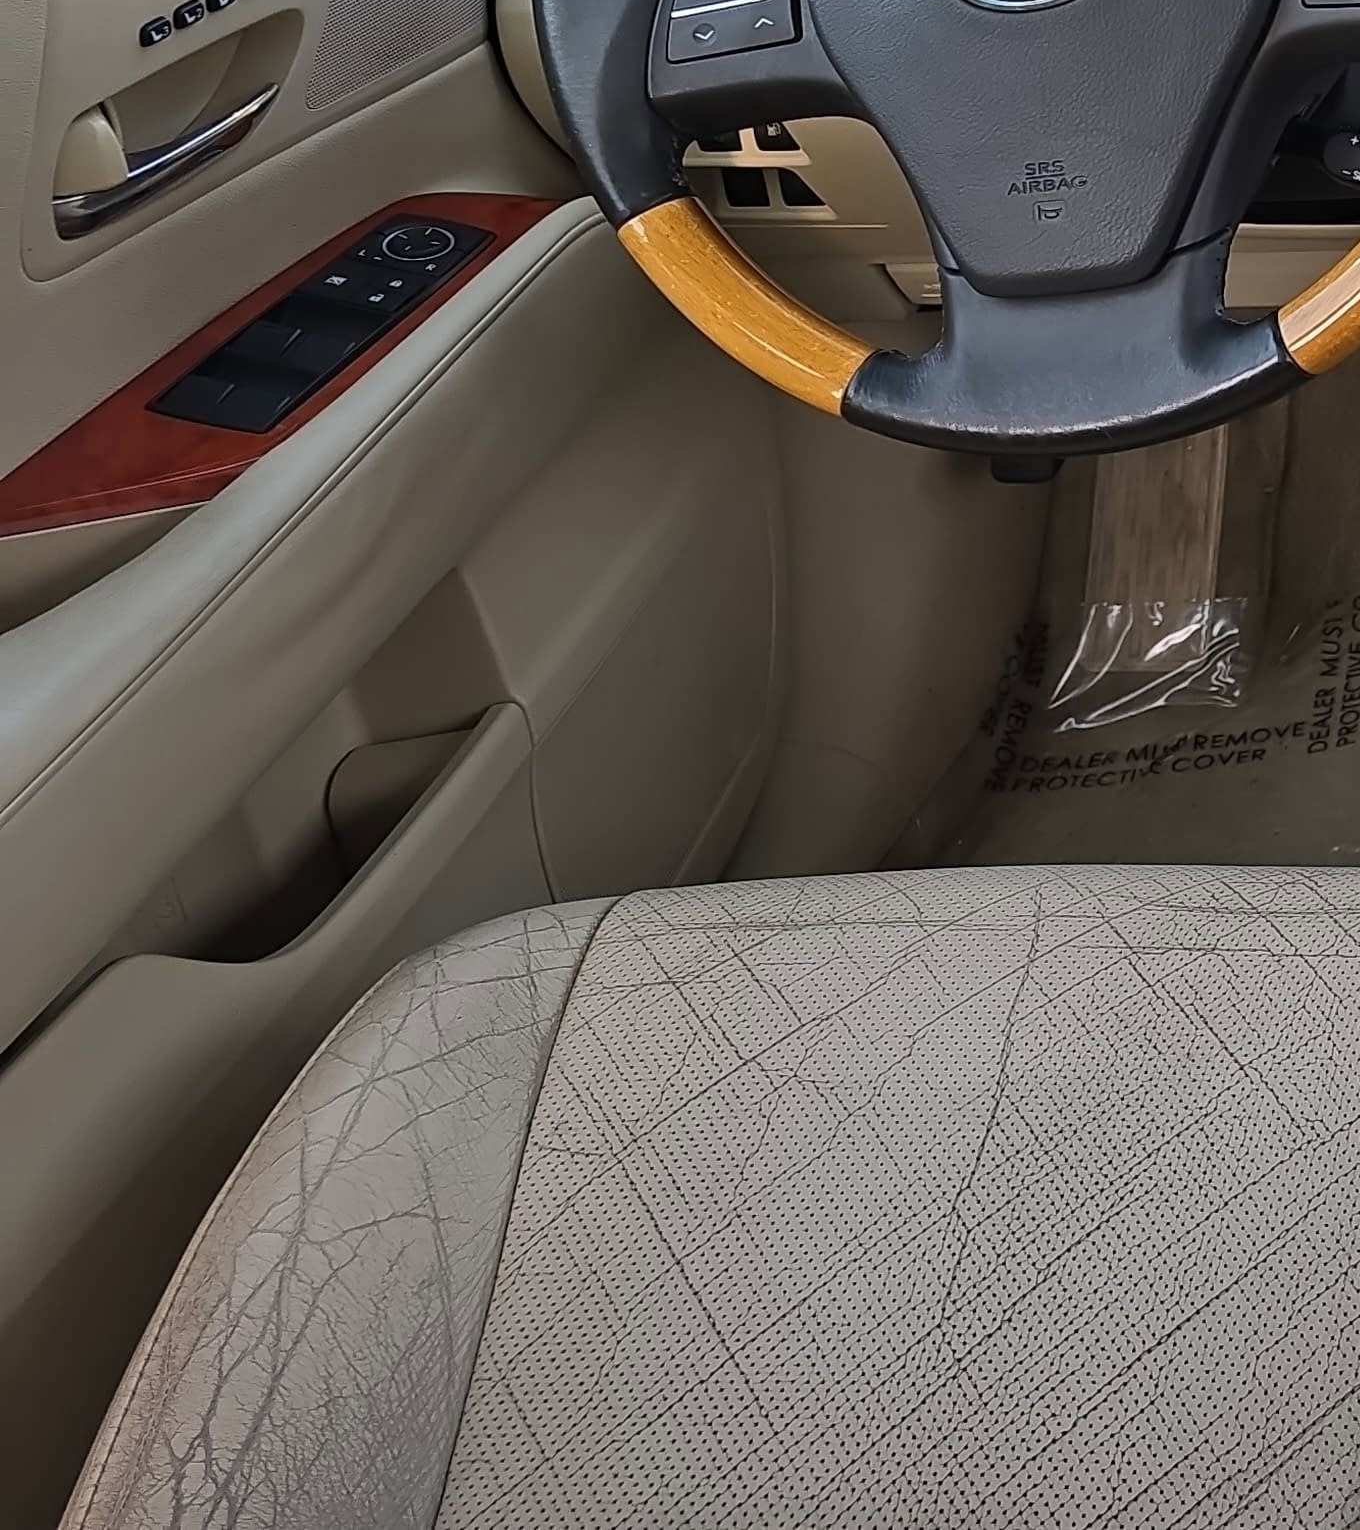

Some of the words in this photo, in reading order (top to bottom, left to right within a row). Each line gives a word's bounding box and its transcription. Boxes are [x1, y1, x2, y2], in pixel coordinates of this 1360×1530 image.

[1025, 160, 1065, 176] SRS
[1007, 175, 1088, 196] AIRBAG
[1307, 686, 1337, 754] DEALER
[1020, 751, 1118, 773] DEALER
[1191, 721, 1308, 751] REMOVE
[1171, 749, 1266, 772] COVER
